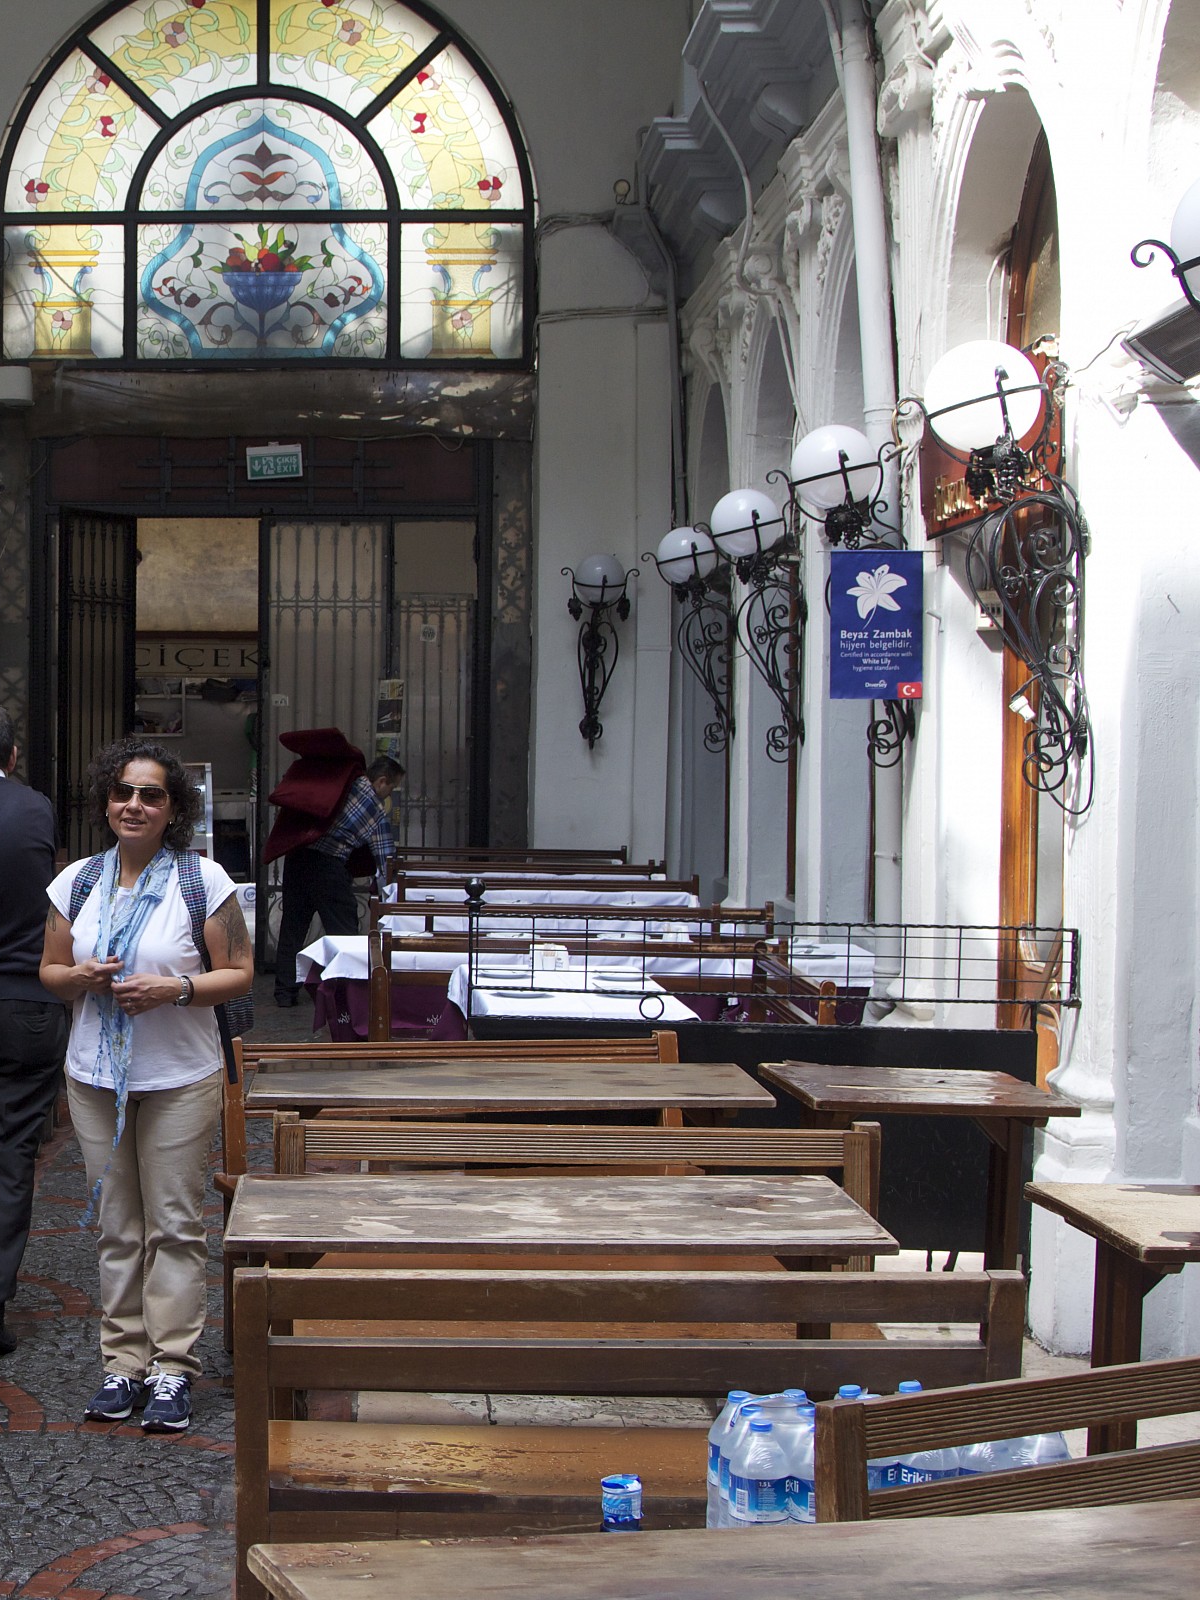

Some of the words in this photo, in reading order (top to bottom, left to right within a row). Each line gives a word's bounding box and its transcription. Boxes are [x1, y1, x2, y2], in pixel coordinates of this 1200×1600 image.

[276, 455, 297, 465] ÇIKIŞ
[276, 464, 297, 473] EXIT
[840, 630, 869, 641] Beyaz
[873, 629, 912, 639] Zambak
[840, 640, 866, 651] hijyen
[869, 640, 912, 651] belgelidir.
[880, 658, 891, 666] Lily
[901, 1468, 932, 1483] Erikli
